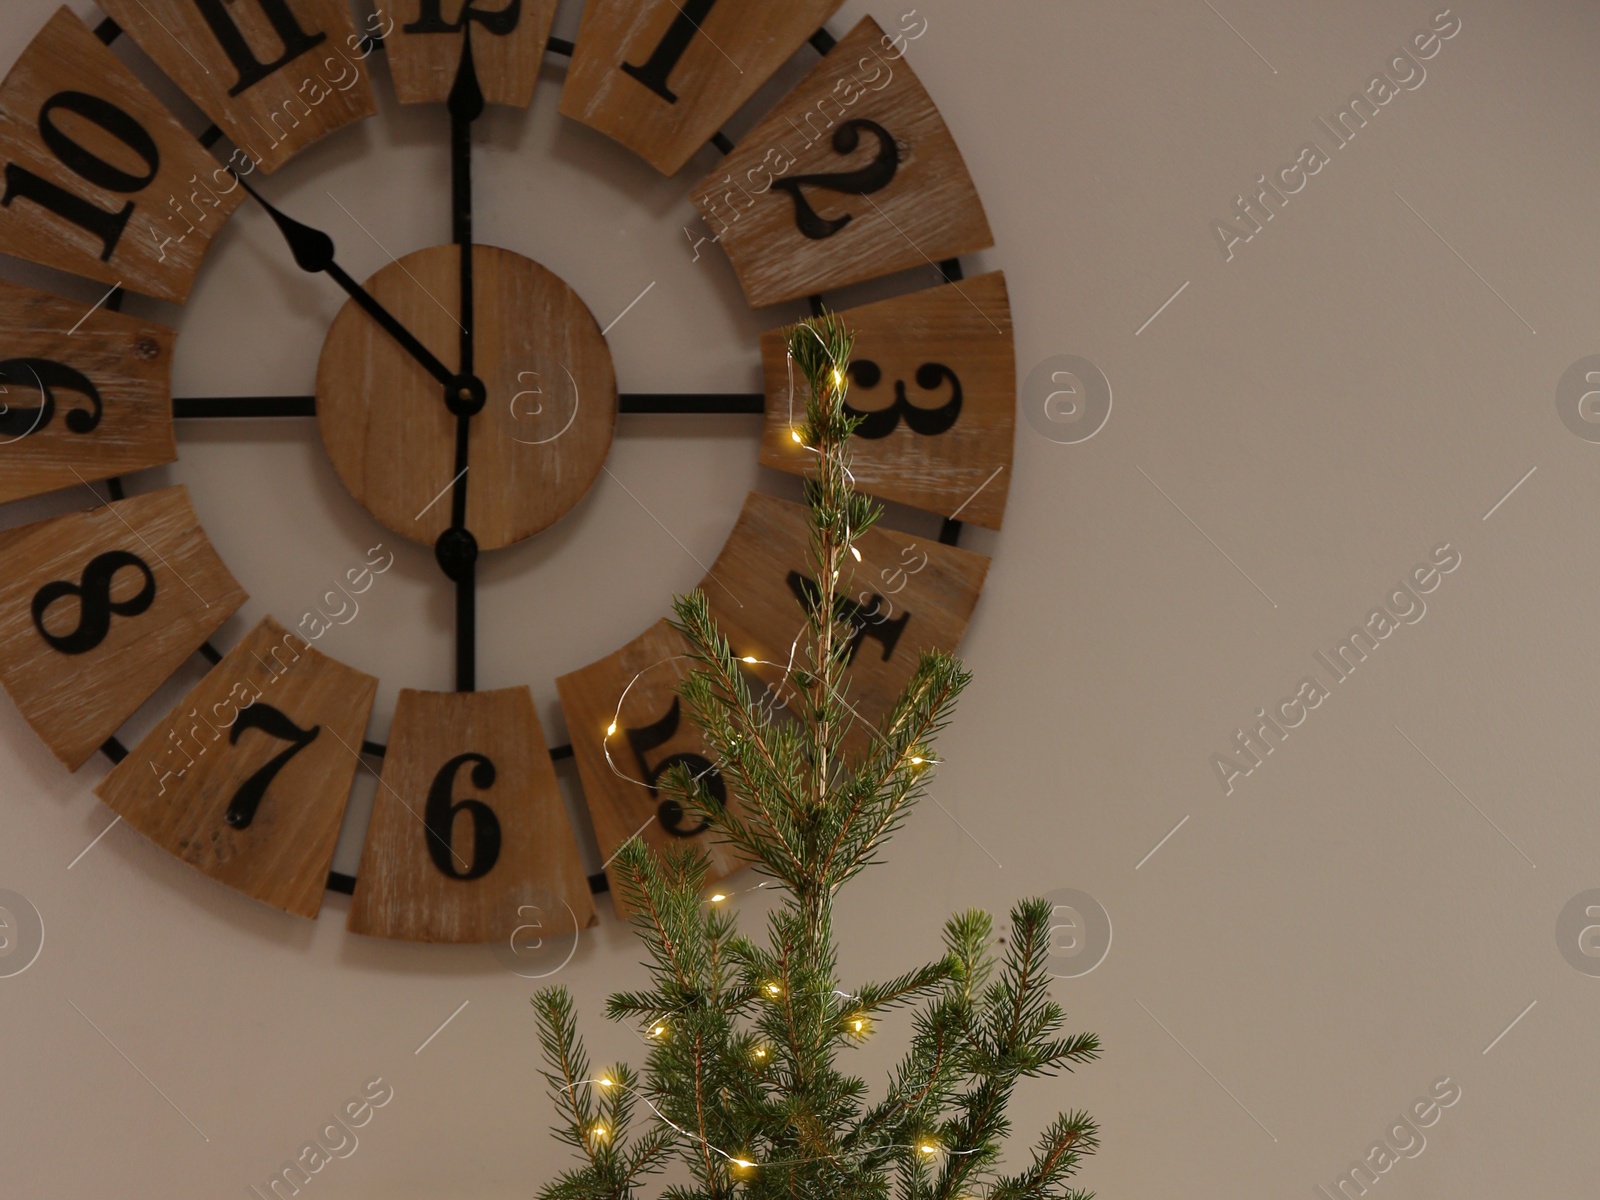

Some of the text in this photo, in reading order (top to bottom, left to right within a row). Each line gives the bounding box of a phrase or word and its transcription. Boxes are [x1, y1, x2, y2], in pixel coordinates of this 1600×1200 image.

[2, 91, 159, 262] 10
[769, 118, 898, 240] 2
[0, 357, 103, 437] 9
[833, 359, 963, 440] 3
[32, 551, 156, 655] 8
[226, 702, 321, 831] 7
[424, 753, 502, 882] 6
[625, 696, 727, 838] 5
